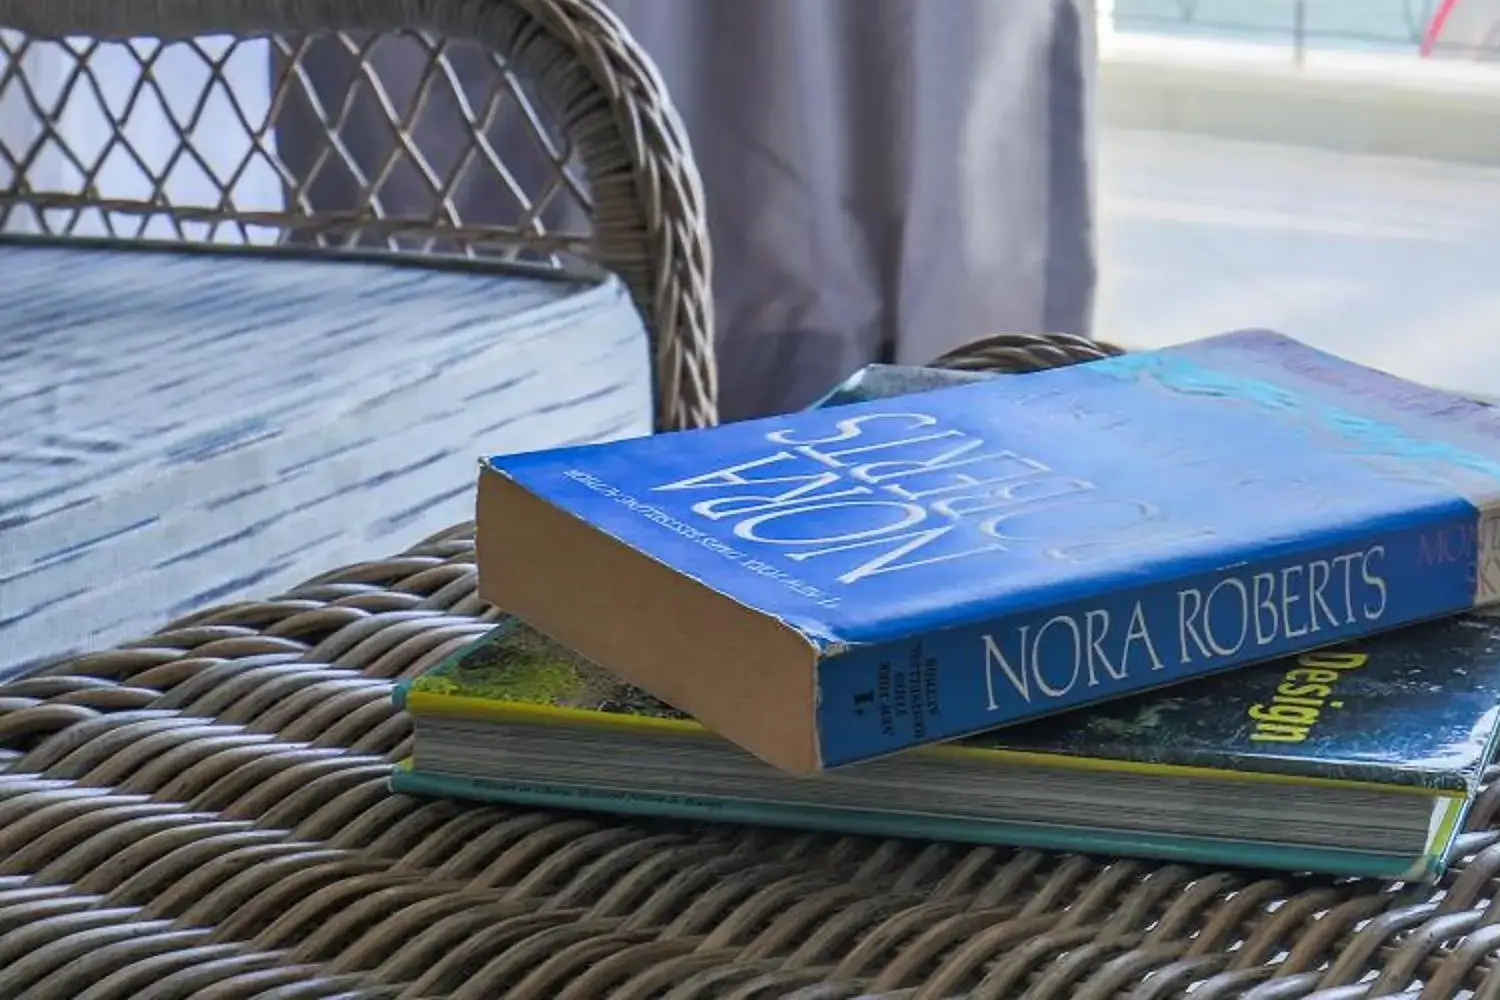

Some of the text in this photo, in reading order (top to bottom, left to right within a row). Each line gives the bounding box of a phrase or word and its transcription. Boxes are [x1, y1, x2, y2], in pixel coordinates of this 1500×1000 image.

[648, 450, 1011, 584] NORA
[981, 545, 1388, 711] NORA ROBERTS
[1248, 651, 1368, 743] Design
